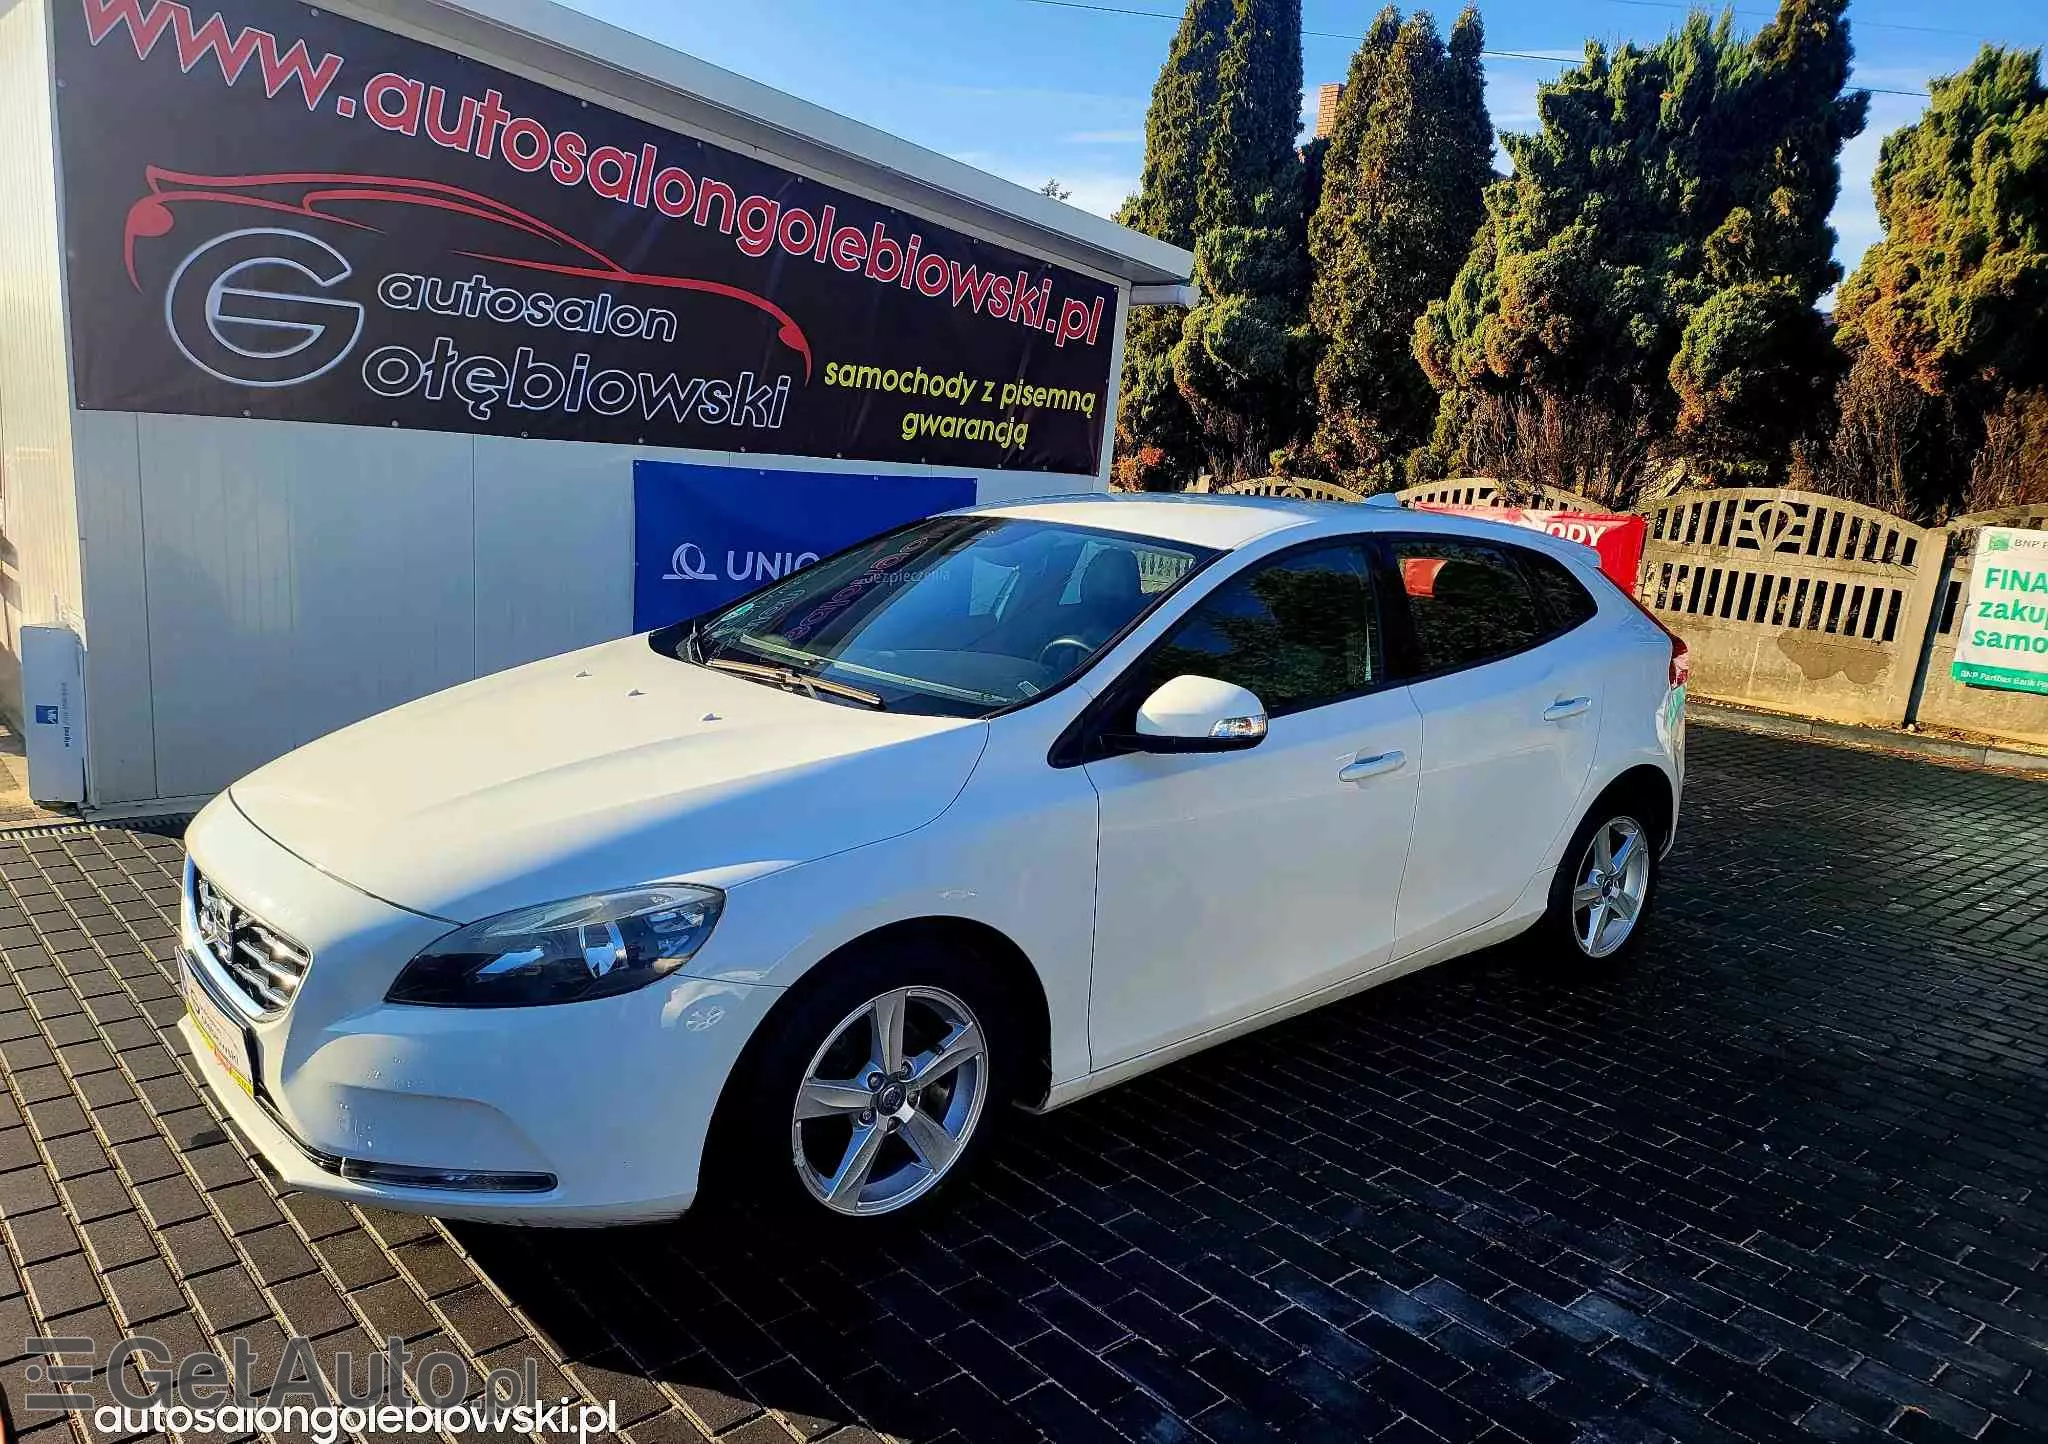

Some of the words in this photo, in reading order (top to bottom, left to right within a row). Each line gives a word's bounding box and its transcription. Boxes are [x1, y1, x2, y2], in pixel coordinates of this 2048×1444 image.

[83, 0, 1104, 346] www.autosalongolebiowski.pl
[378, 273, 677, 342] autosalon
[825, 362, 977, 405] samochody
[981, 380, 996, 402] z
[1000, 379, 1096, 418] pisemną
[902, 412, 1029, 450] gwarancją
[1978, 600, 2048, 631] zaku
